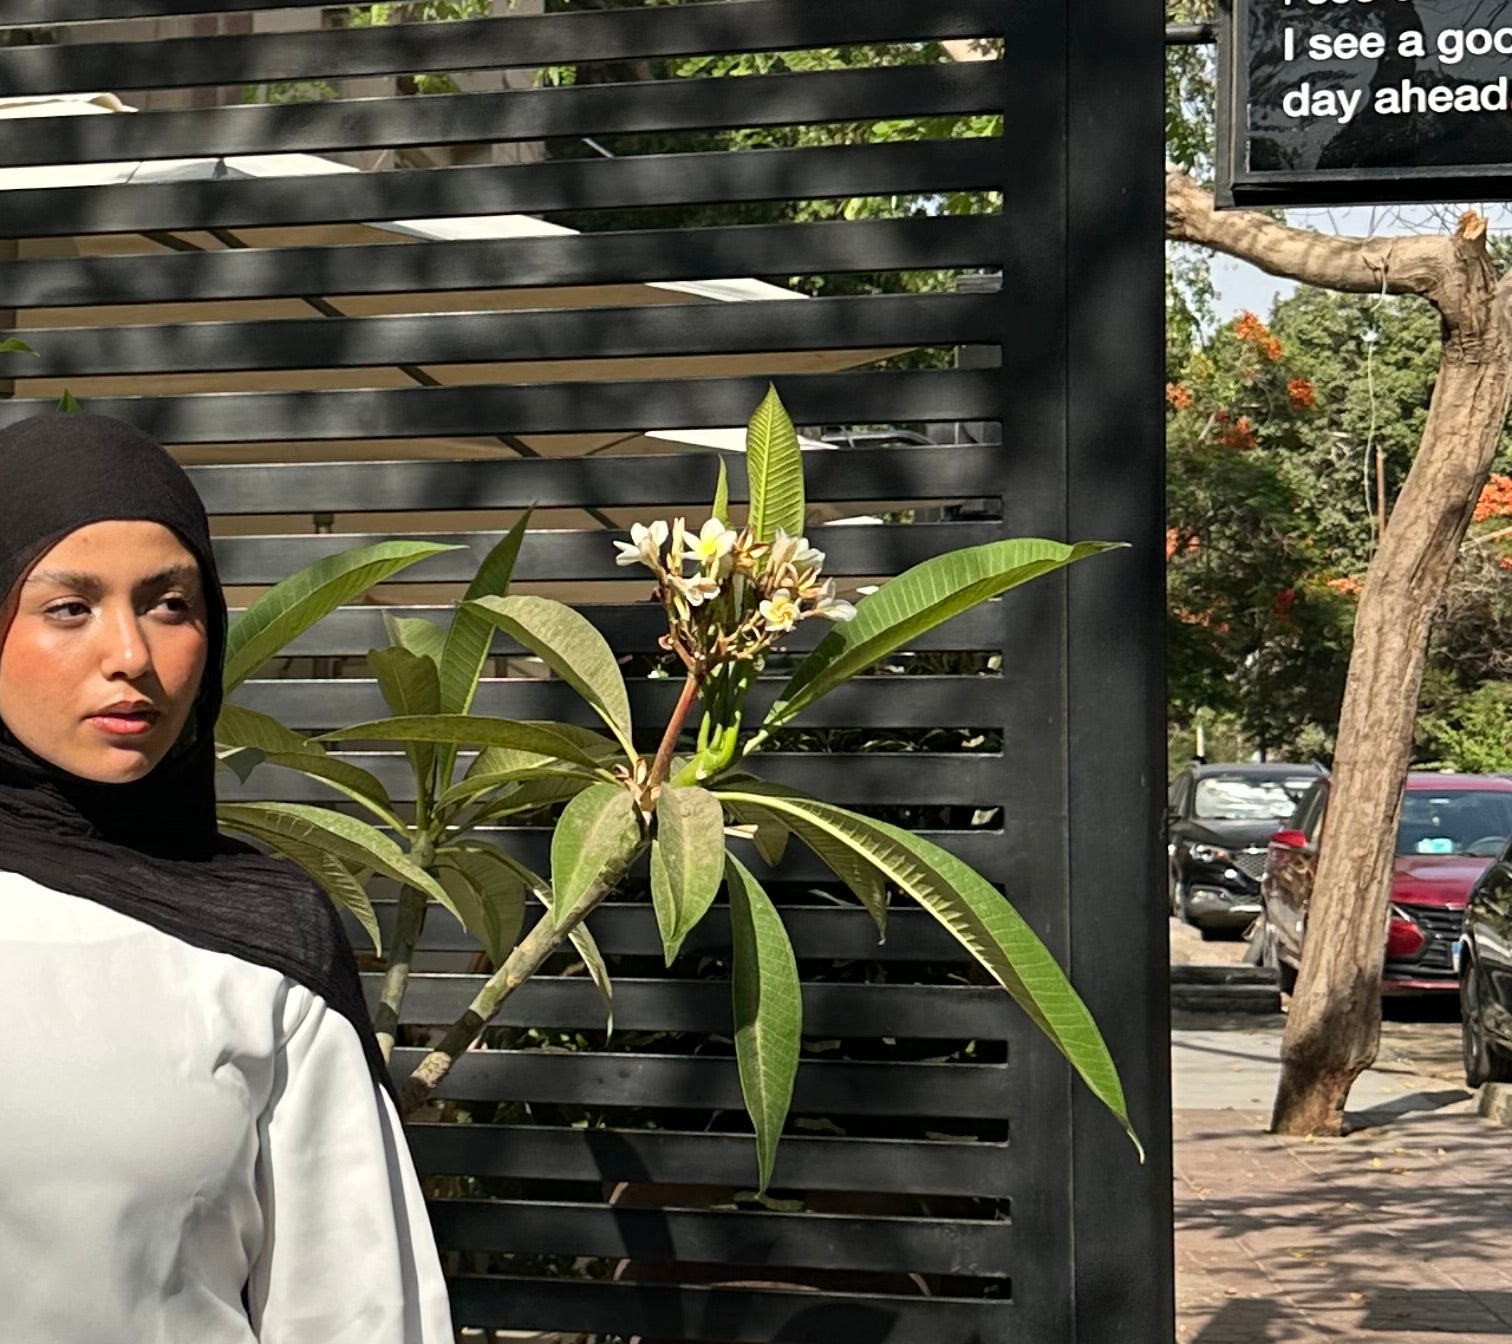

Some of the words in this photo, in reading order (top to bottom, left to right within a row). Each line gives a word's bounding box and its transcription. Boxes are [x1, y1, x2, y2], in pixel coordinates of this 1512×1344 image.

[1284, 27, 1294, 61] I
[1308, 31, 1386, 61] see
[1397, 30, 1425, 58] a
[1282, 82, 1362, 124] day
